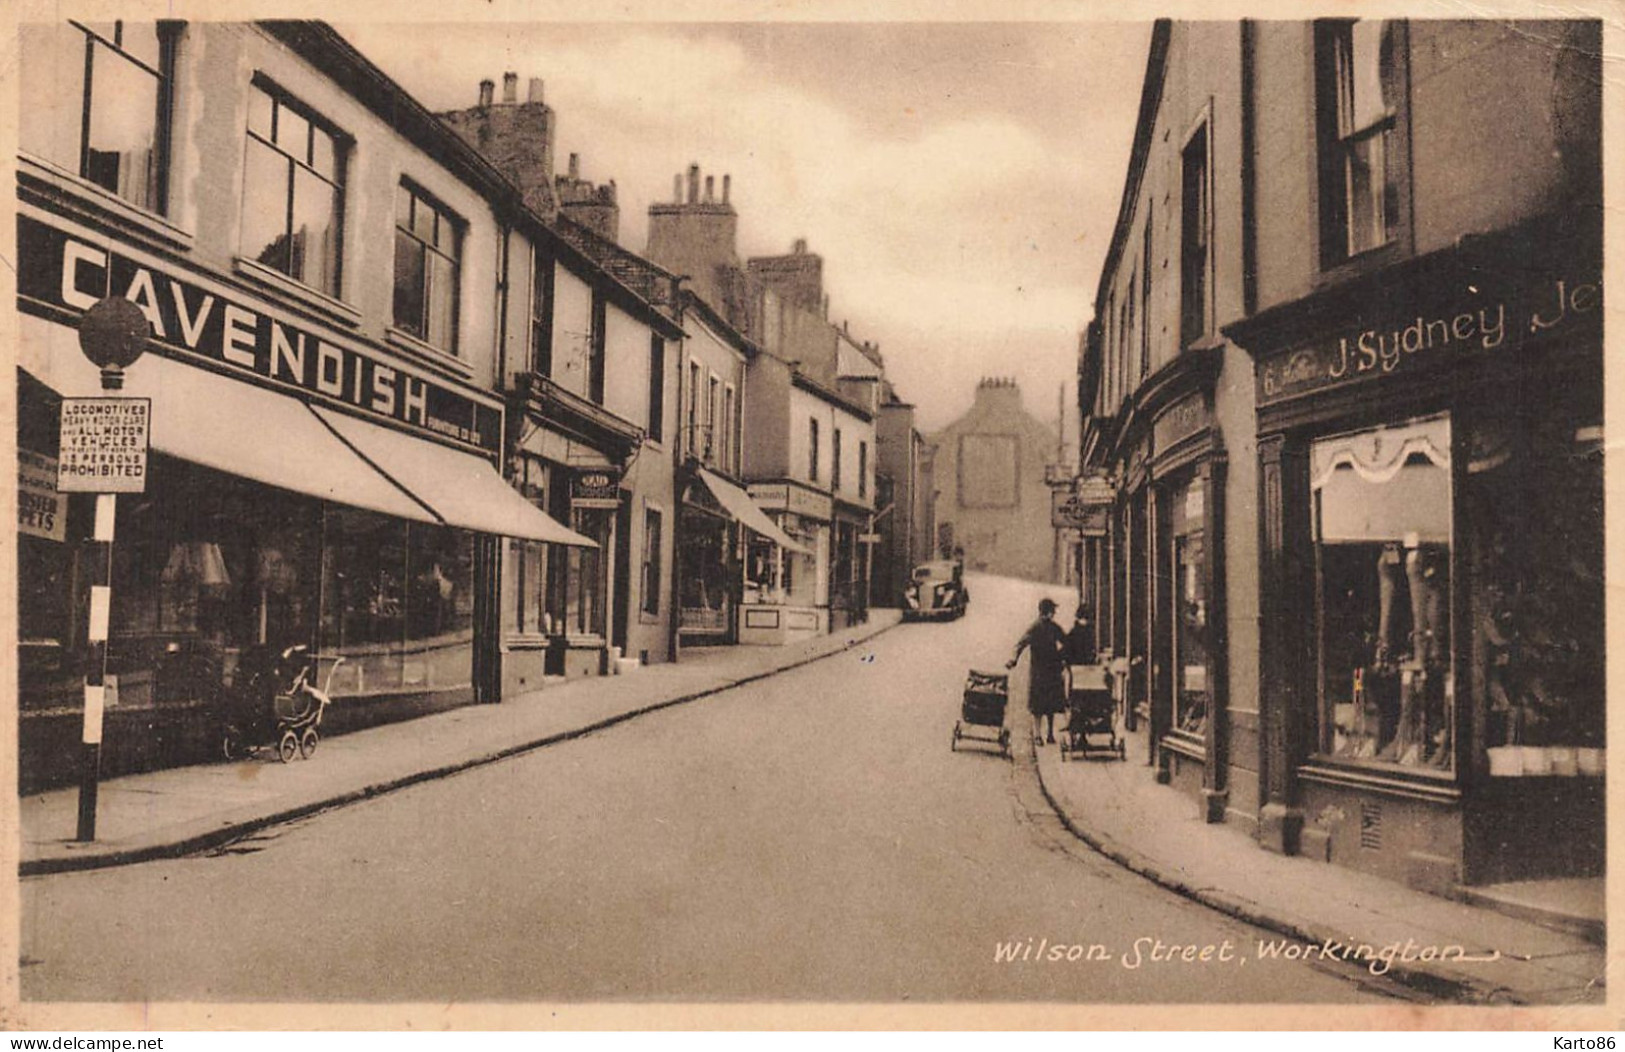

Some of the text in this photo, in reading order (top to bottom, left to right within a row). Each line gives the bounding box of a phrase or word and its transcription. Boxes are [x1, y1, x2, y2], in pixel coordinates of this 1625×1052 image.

[61, 239, 428, 427] CAVENDISH
[1357, 304, 1505, 373] Sydney
[65, 405, 145, 415] LOCOMOTIVES
[62, 416, 145, 426] HEAVY MOTOR CARS
[79, 427, 99, 436] ALL
[104, 427, 144, 436] MOTOR
[72, 437, 137, 446] VEHICLES
[83, 454, 140, 464] PERSONS
[61, 465, 143, 476] PROHIBITED
